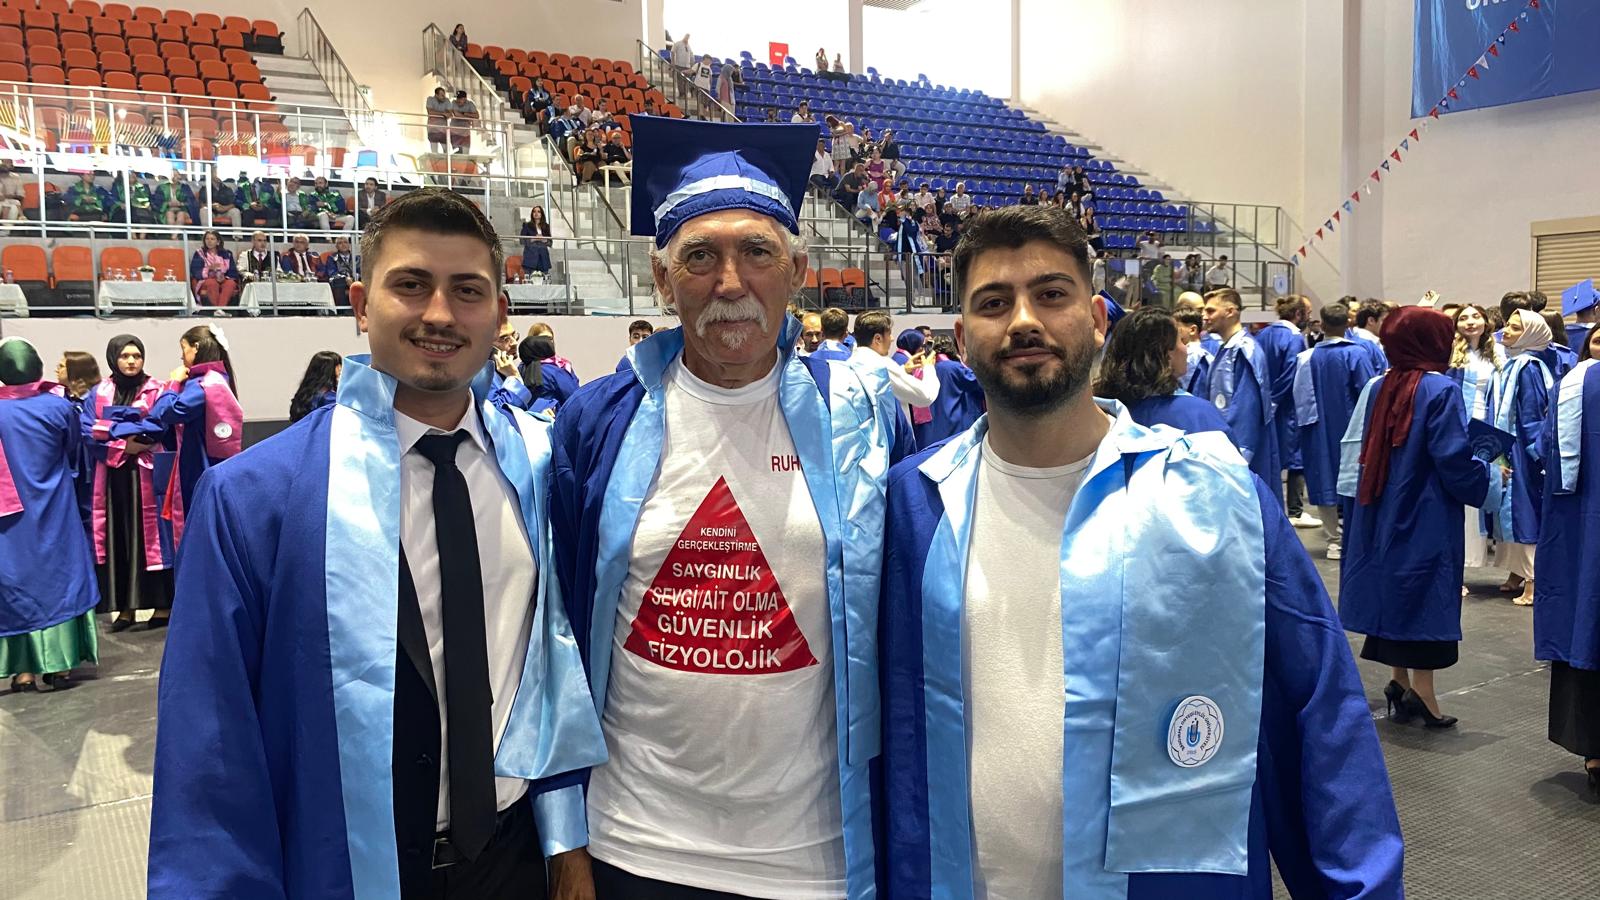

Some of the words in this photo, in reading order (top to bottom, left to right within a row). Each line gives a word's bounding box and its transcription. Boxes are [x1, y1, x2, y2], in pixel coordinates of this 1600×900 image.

[771, 455, 800, 472] RUH
[700, 526, 736, 537] KENDİNİ
[678, 540, 758, 552] GERÇEKLEŞTİRME
[673, 562, 761, 581] SAYGINLIK
[652, 585, 728, 610] SEVGİ/AİT
[733, 591, 778, 611] OLMA
[657, 611, 773, 639] GÜVENLİK
[648, 638, 781, 669] FİZYOLOJİK
